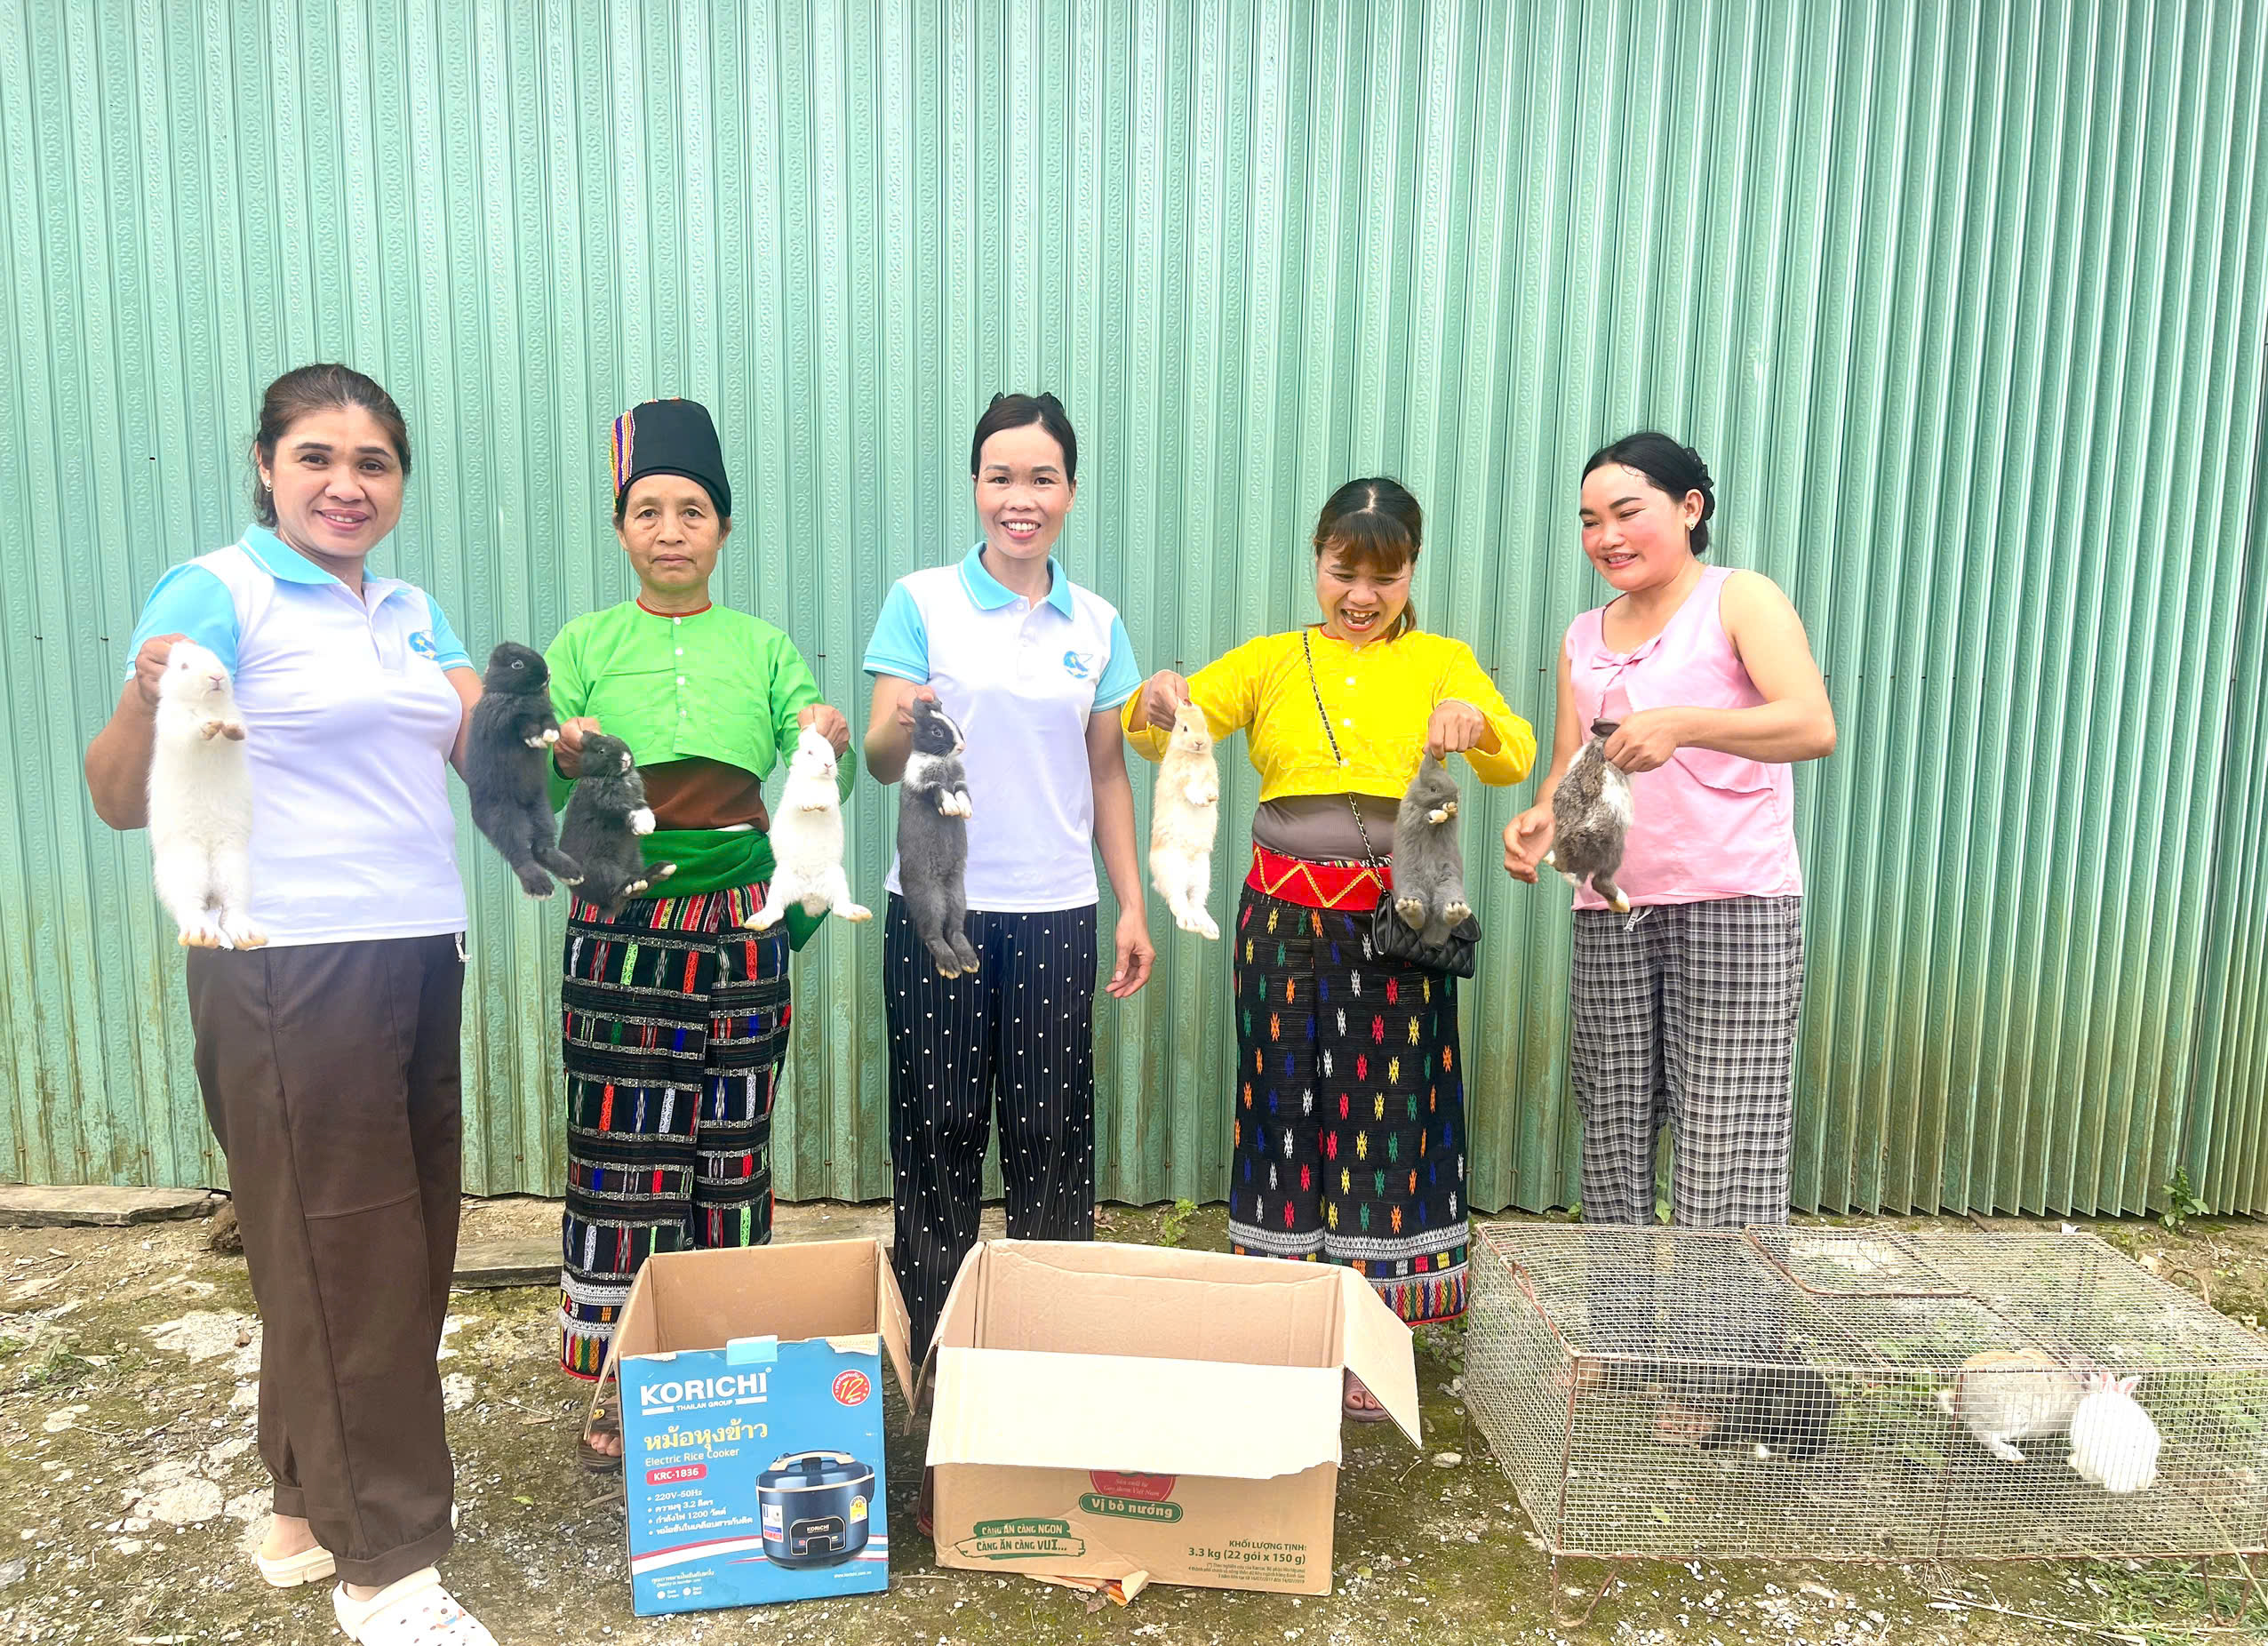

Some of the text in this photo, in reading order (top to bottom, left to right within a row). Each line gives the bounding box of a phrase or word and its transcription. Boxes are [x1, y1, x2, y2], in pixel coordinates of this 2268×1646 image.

[640, 1371, 768, 1406] KORICHI
[840, 1378, 865, 1401] 12
[676, 1399, 733, 1411] THAILAN GROUP
[643, 1418, 768, 1450] หม้อหุงข้าว
[645, 1449, 739, 1466] Electric Rice Cooker
[654, 1467, 699, 1482] KRC-1836
[683, 1499, 696, 1508] 3.2
[1091, 1498, 1173, 1518] Vị bò nướng
[688, 1510, 708, 1519] 1200
[1038, 1524, 1063, 1534] NGON
[1000, 1538, 1012, 1550] ĂN
[1037, 1538, 1067, 1551] VUI...
[1229, 1538, 1307, 1553] KHỐI LƯỢNG TỊNH:
[1188, 1547, 1204, 1557] 3.3
[1208, 1548, 1221, 1560] kg
[1224, 1549, 1241, 1561] (22
[1243, 1551, 1261, 1562] gói
[1273, 1553, 1292, 1562] 150
[1295, 1554, 1306, 1565] g)
